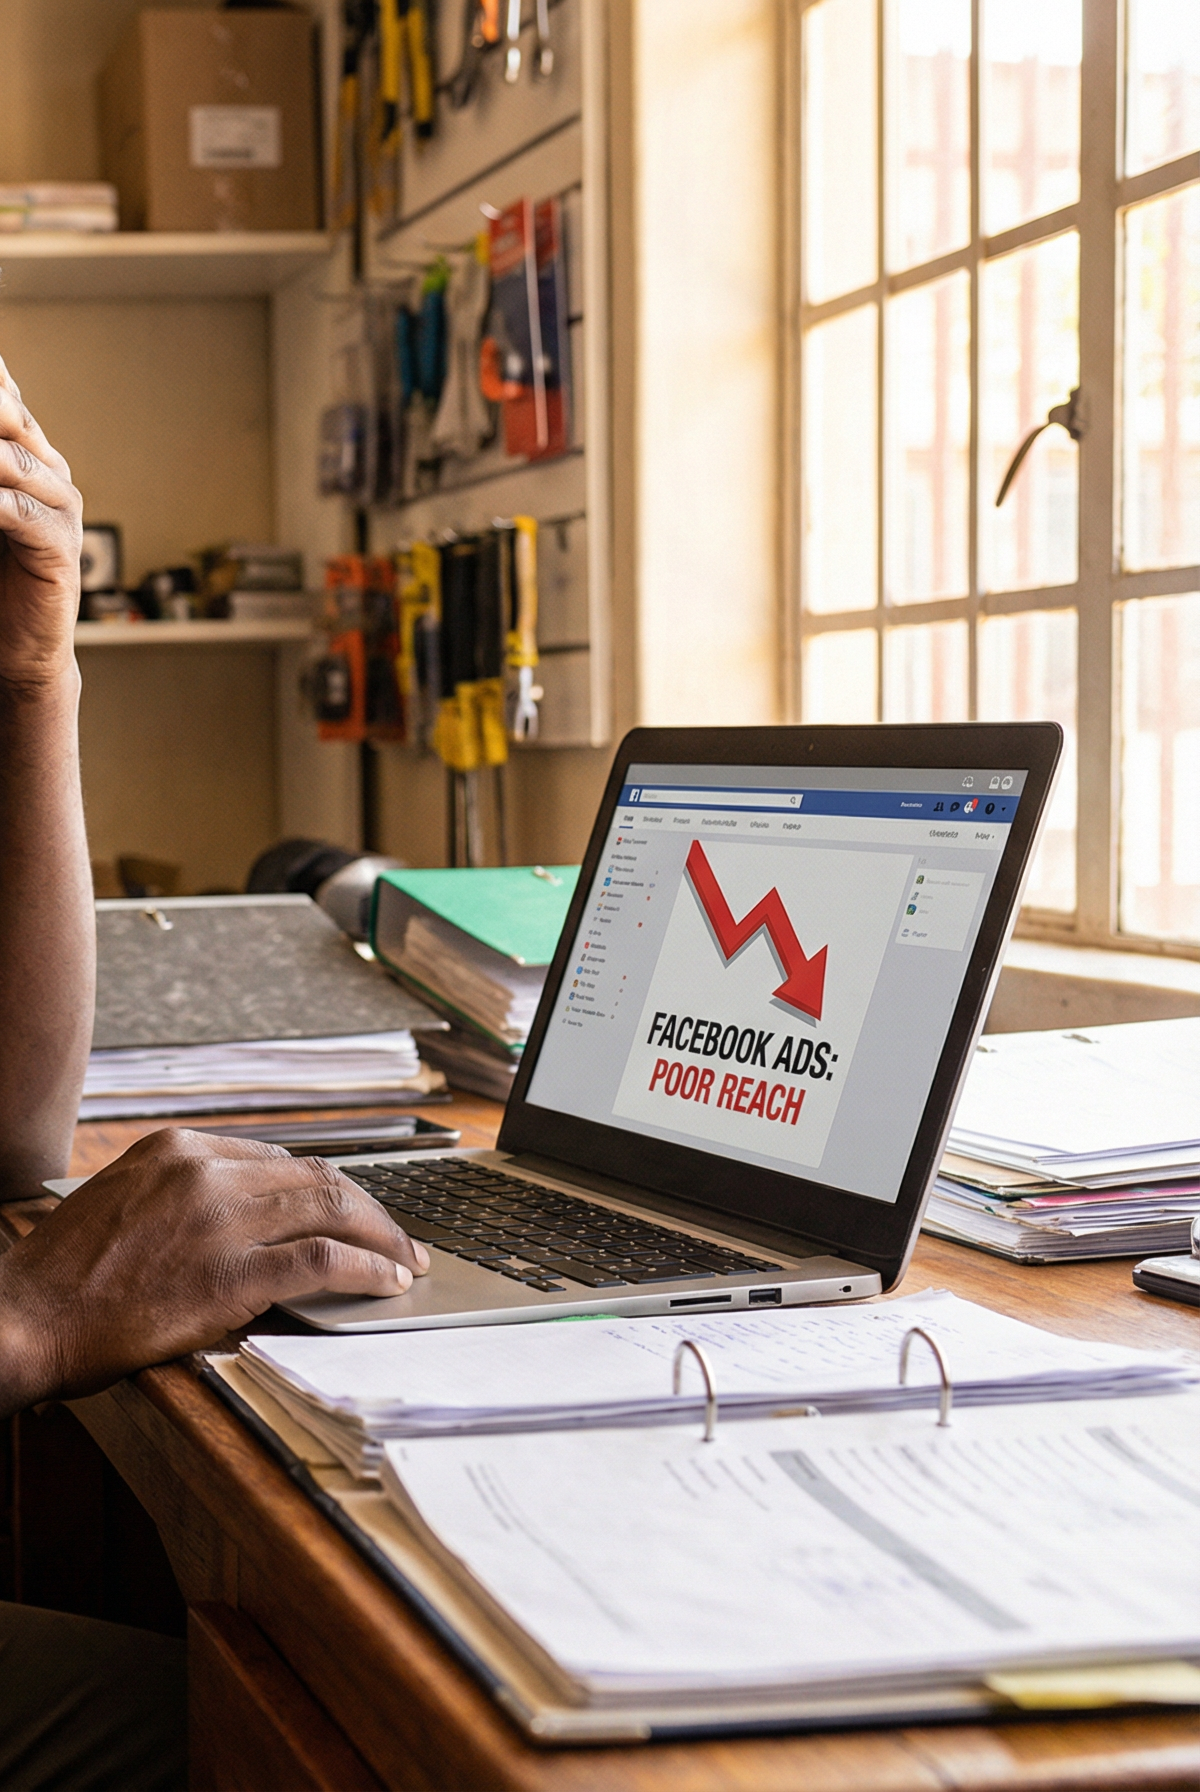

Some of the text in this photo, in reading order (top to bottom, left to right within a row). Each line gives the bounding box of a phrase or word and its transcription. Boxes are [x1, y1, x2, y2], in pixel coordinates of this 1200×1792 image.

[647, 1011, 839, 1081] FACEBOOK ADS:
[648, 1058, 807, 1126] POOR REACH
